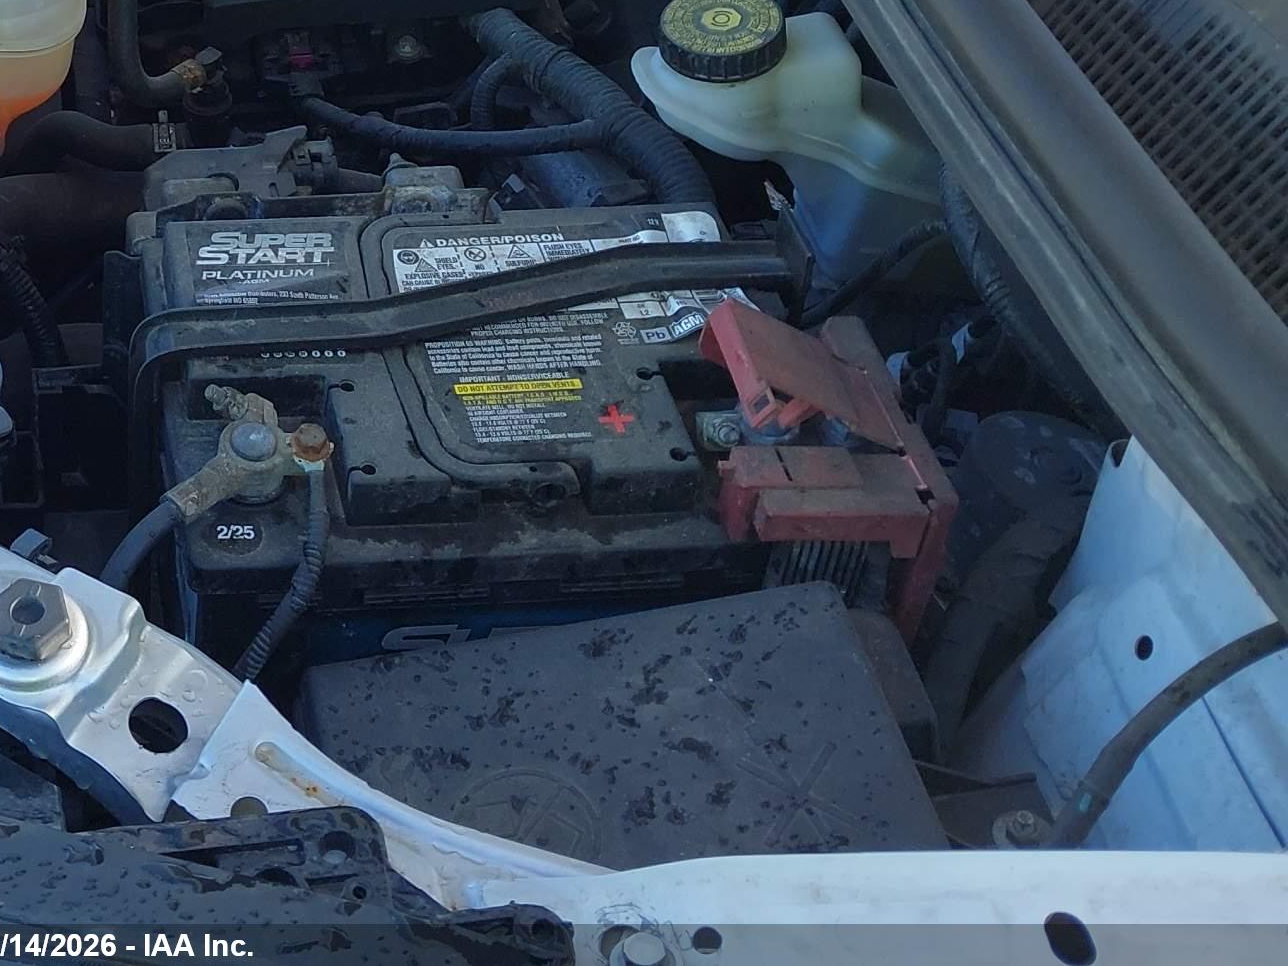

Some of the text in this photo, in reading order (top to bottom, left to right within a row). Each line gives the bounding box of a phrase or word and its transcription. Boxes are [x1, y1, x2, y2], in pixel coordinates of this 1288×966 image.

[210, 232, 332, 249] SUPER
[435, 233, 564, 247] DANGER/POISON
[196, 246, 334, 265] START
[202, 269, 314, 280] PLATINUM
[674, 314, 705, 336] AGM
[645, 331, 665, 340] Pb
[459, 375, 501, 383] IMPORTANT
[216, 525, 255, 540] 2/25
